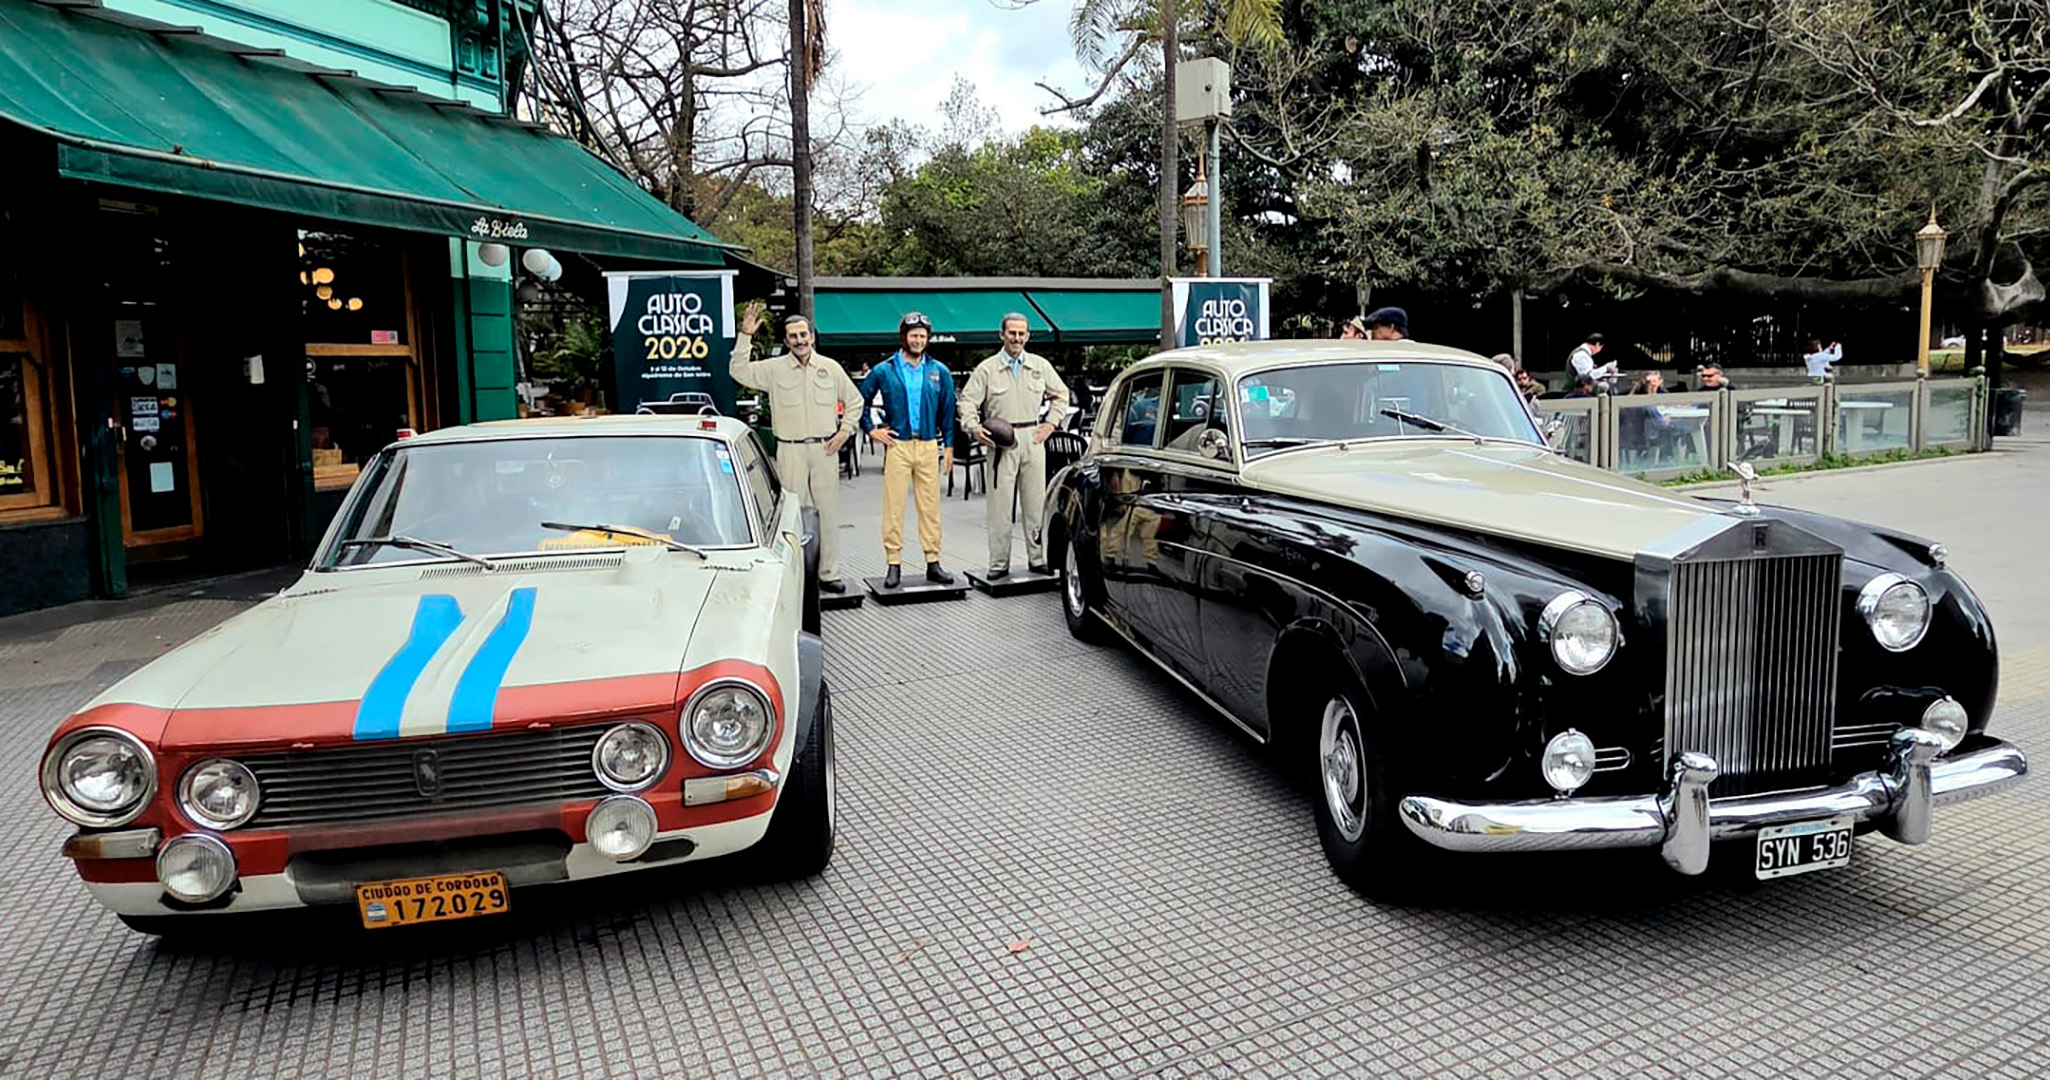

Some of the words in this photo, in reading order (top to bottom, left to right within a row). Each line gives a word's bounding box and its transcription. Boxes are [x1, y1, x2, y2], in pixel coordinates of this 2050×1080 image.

[471, 217, 490, 237] La
[491, 219, 528, 239] Biela
[647, 293, 702, 315] AUTO
[1203, 299, 1246, 318] AUTO
[644, 336, 709, 360] 2026
[1761, 837, 1801, 869] SYN
[1811, 830, 1849, 861] 536
[362, 884, 411, 900] CIUDAD
[415, 882, 432, 895] DE
